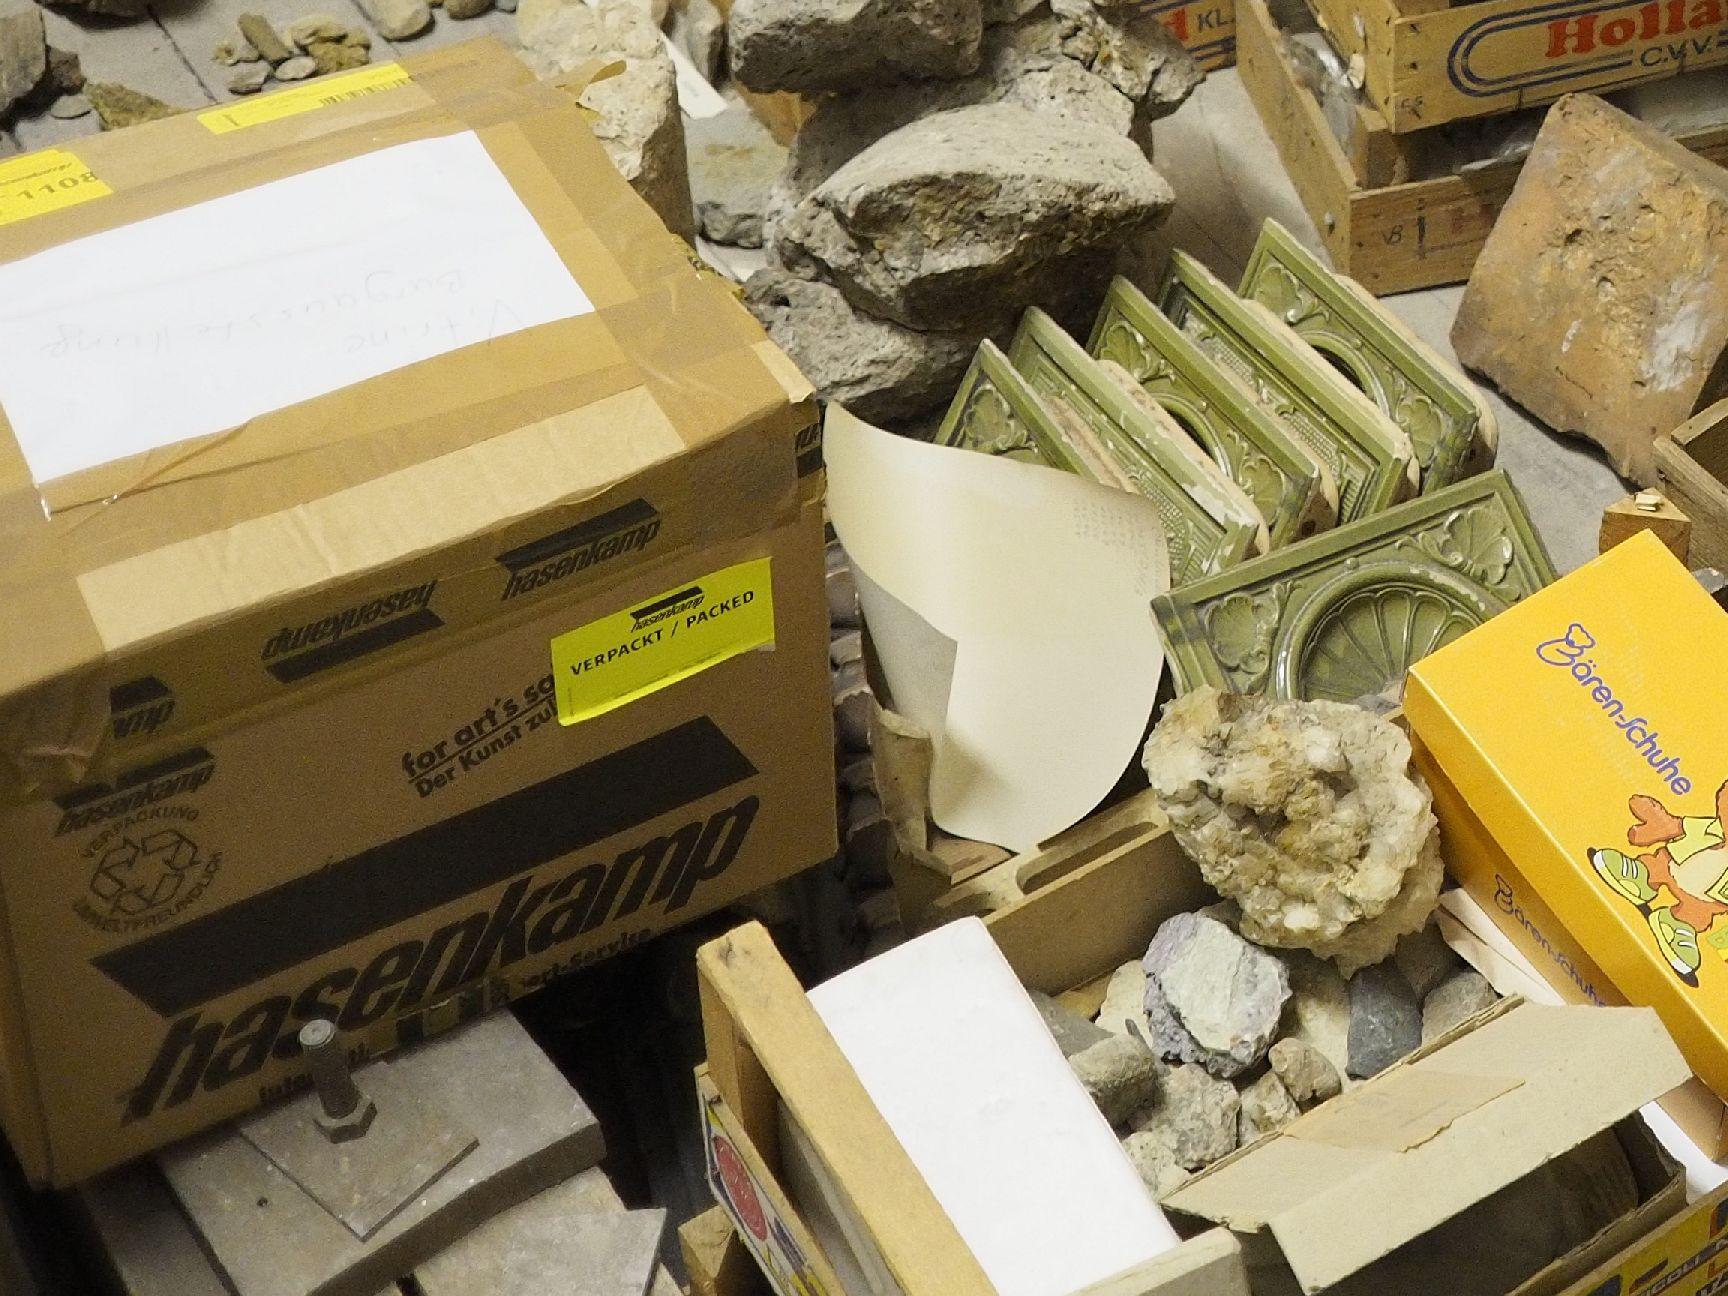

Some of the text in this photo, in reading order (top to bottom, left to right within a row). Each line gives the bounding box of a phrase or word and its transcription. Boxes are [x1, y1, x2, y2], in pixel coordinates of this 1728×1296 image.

[502, 519, 662, 601] hasenkamp
[261, 579, 439, 661] hasenkamp
[570, 629, 666, 677] VERPACKT
[684, 589, 756, 631] PACKED
[401, 736, 448, 778] for
[414, 766, 457, 799] Der
[458, 724, 523, 772] Kunst
[120, 796, 761, 1126] hasenkamp
